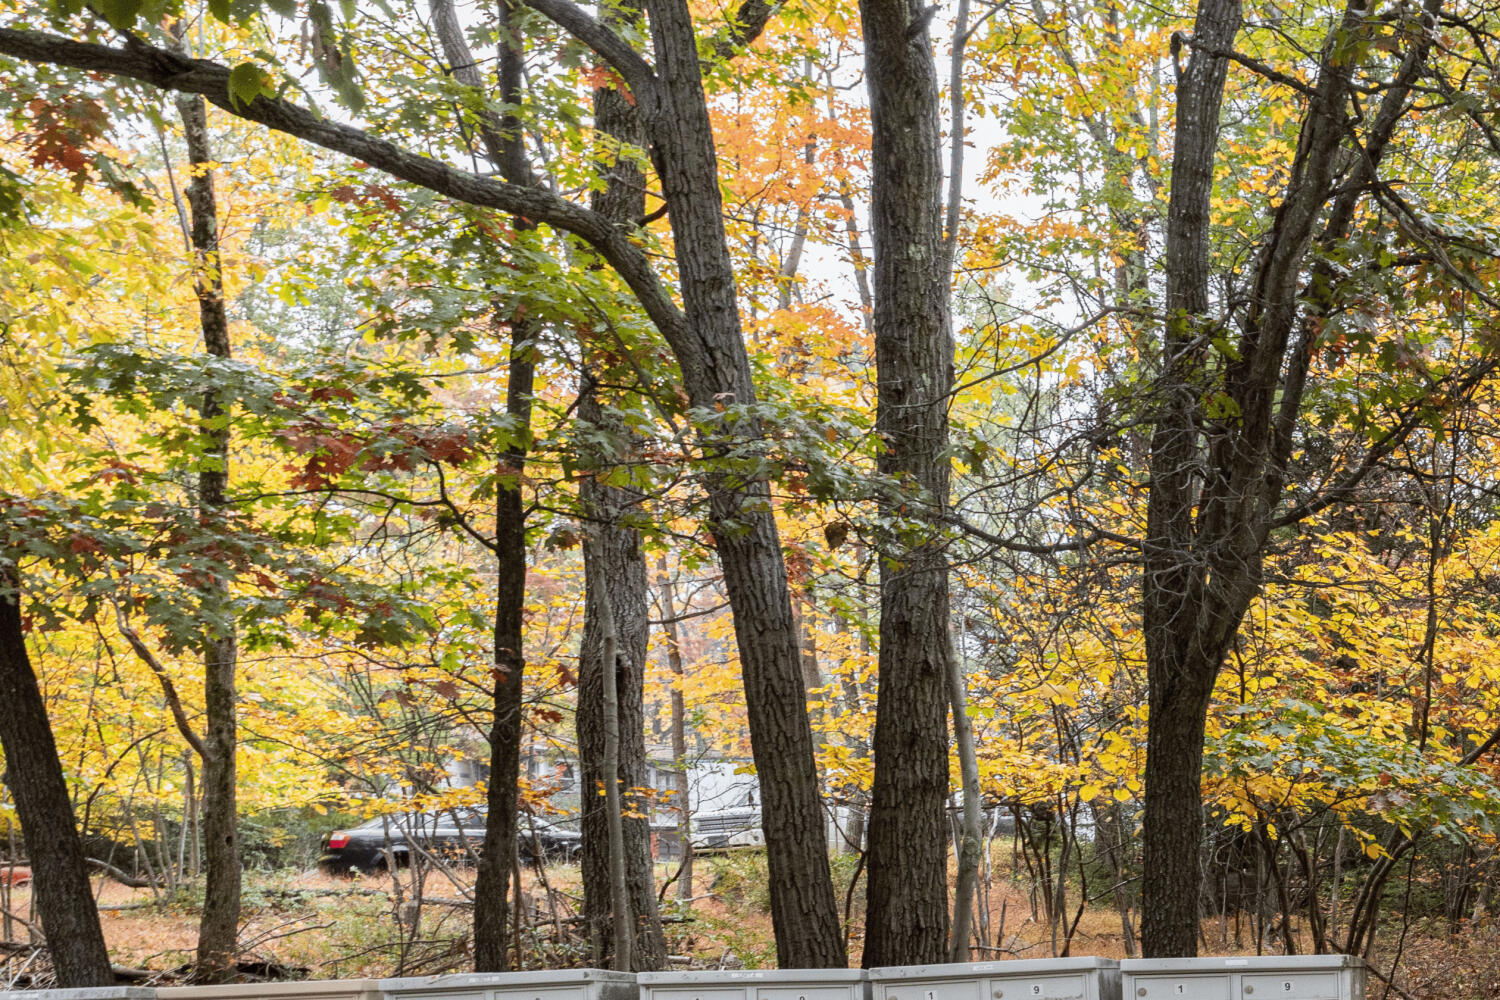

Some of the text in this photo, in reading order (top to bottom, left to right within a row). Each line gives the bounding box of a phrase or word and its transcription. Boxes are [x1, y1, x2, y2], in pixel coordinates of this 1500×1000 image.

[1033, 985, 1040, 995] 9
[1177, 984, 1183, 994] 1
[1284, 982, 1291, 992] 9
[928, 991, 934, 1000] 1
